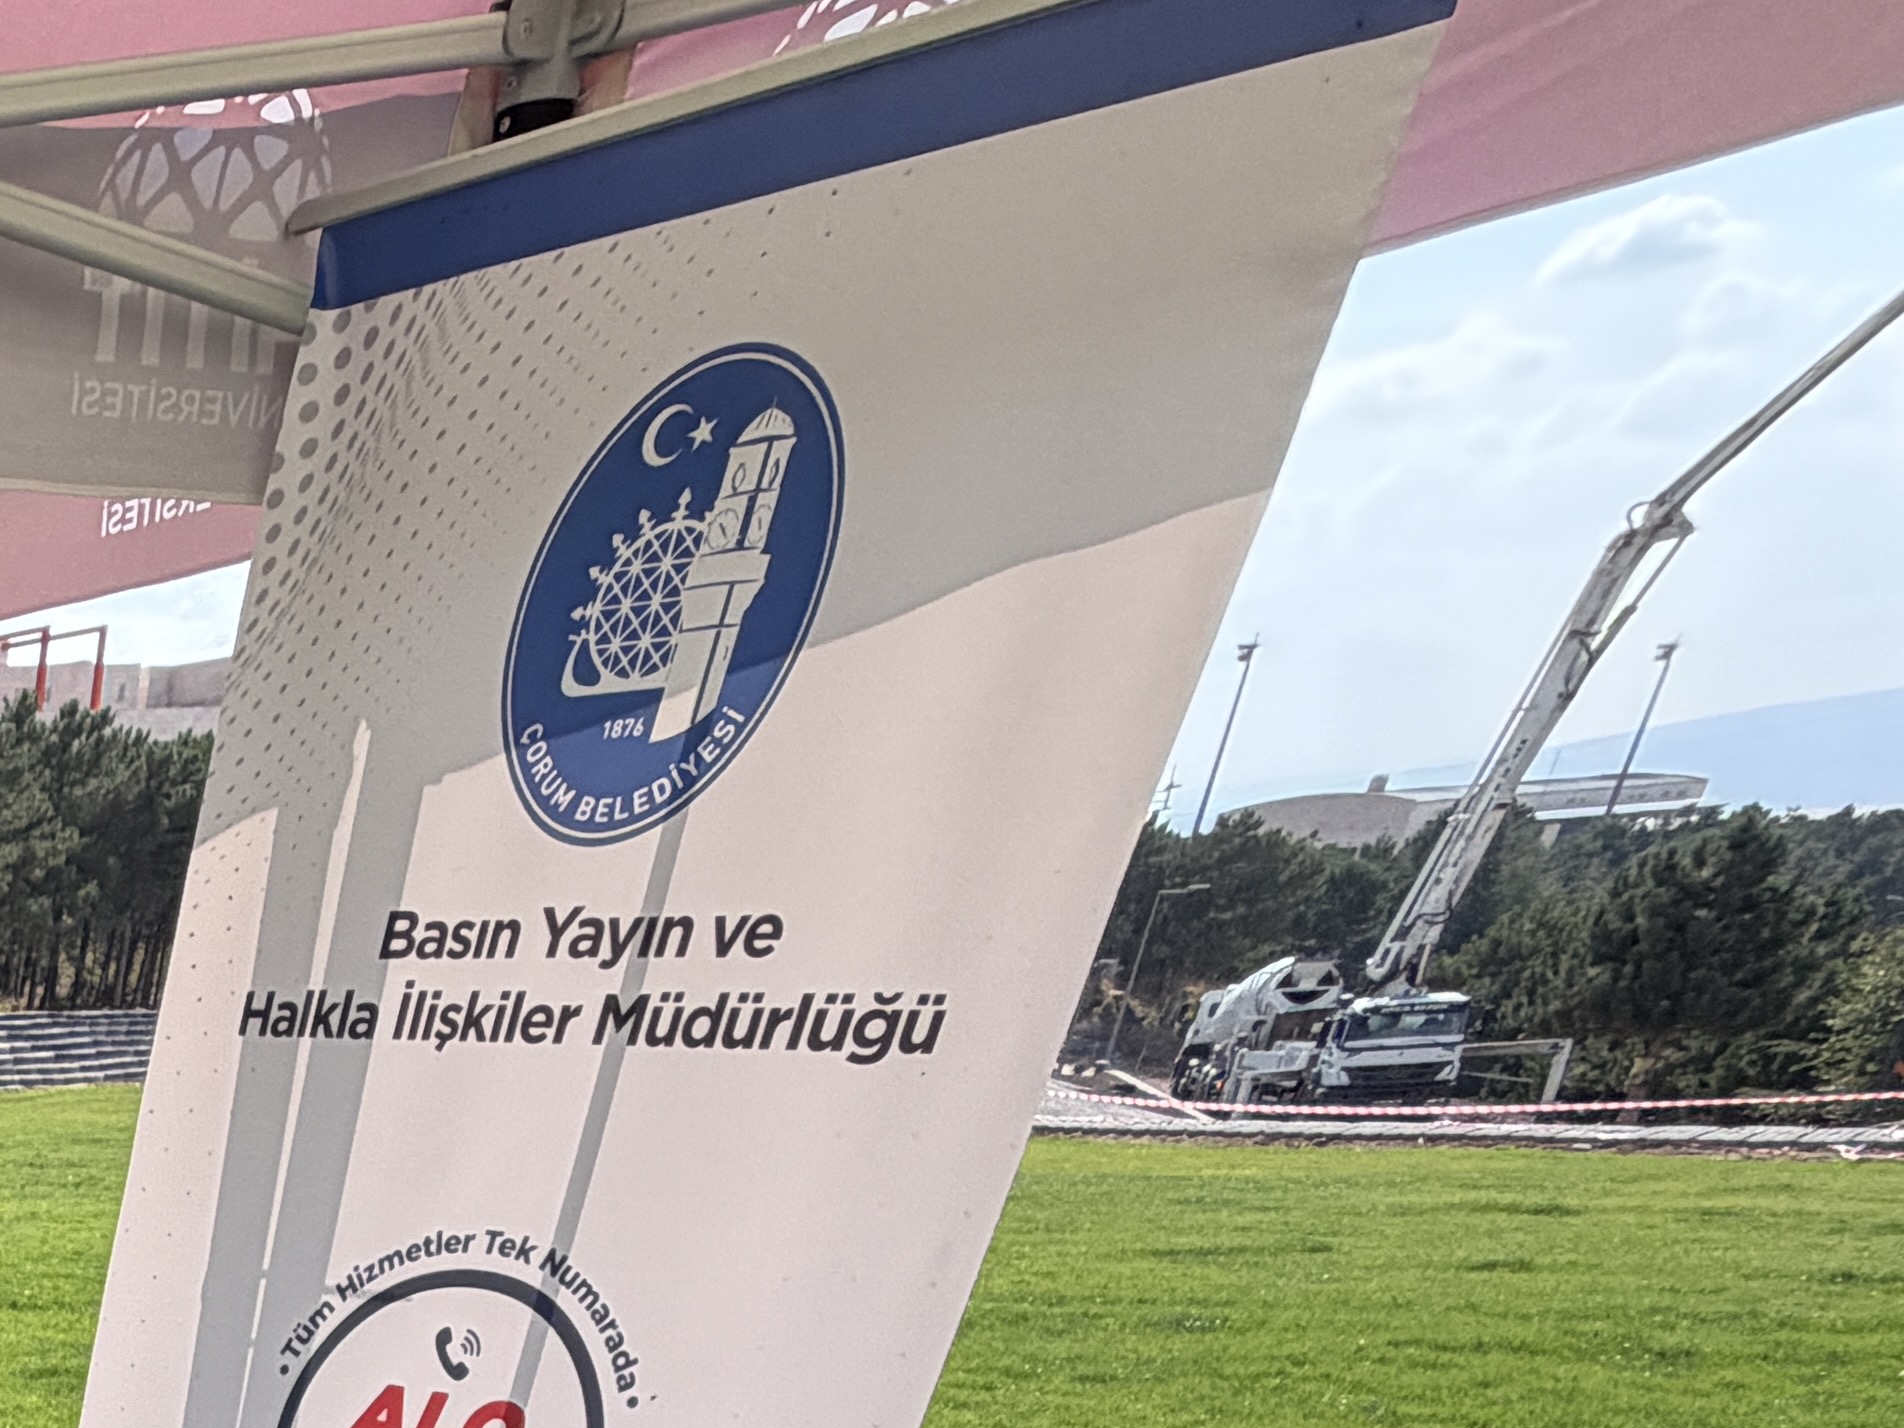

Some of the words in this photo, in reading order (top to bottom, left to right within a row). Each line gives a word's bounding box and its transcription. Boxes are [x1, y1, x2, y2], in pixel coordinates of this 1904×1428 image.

[519, 722, 576, 812] ÇORUM
[574, 705, 745, 823] BELEDİYESİ
[603, 716, 645, 740] 1876
[379, 909, 522, 960] Basın
[542, 904, 694, 970] Yayın
[714, 911, 784, 959] ve
[238, 990, 380, 1040] Halkla
[392, 980, 581, 1053] İlişkiler
[592, 990, 948, 1066] Müdürlüğü
[280, 1300, 336, 1359] Tüm
[335, 1230, 477, 1302] Hizmetler
[484, 1229, 540, 1266] Tek
[537, 1247, 640, 1394] Numarada
